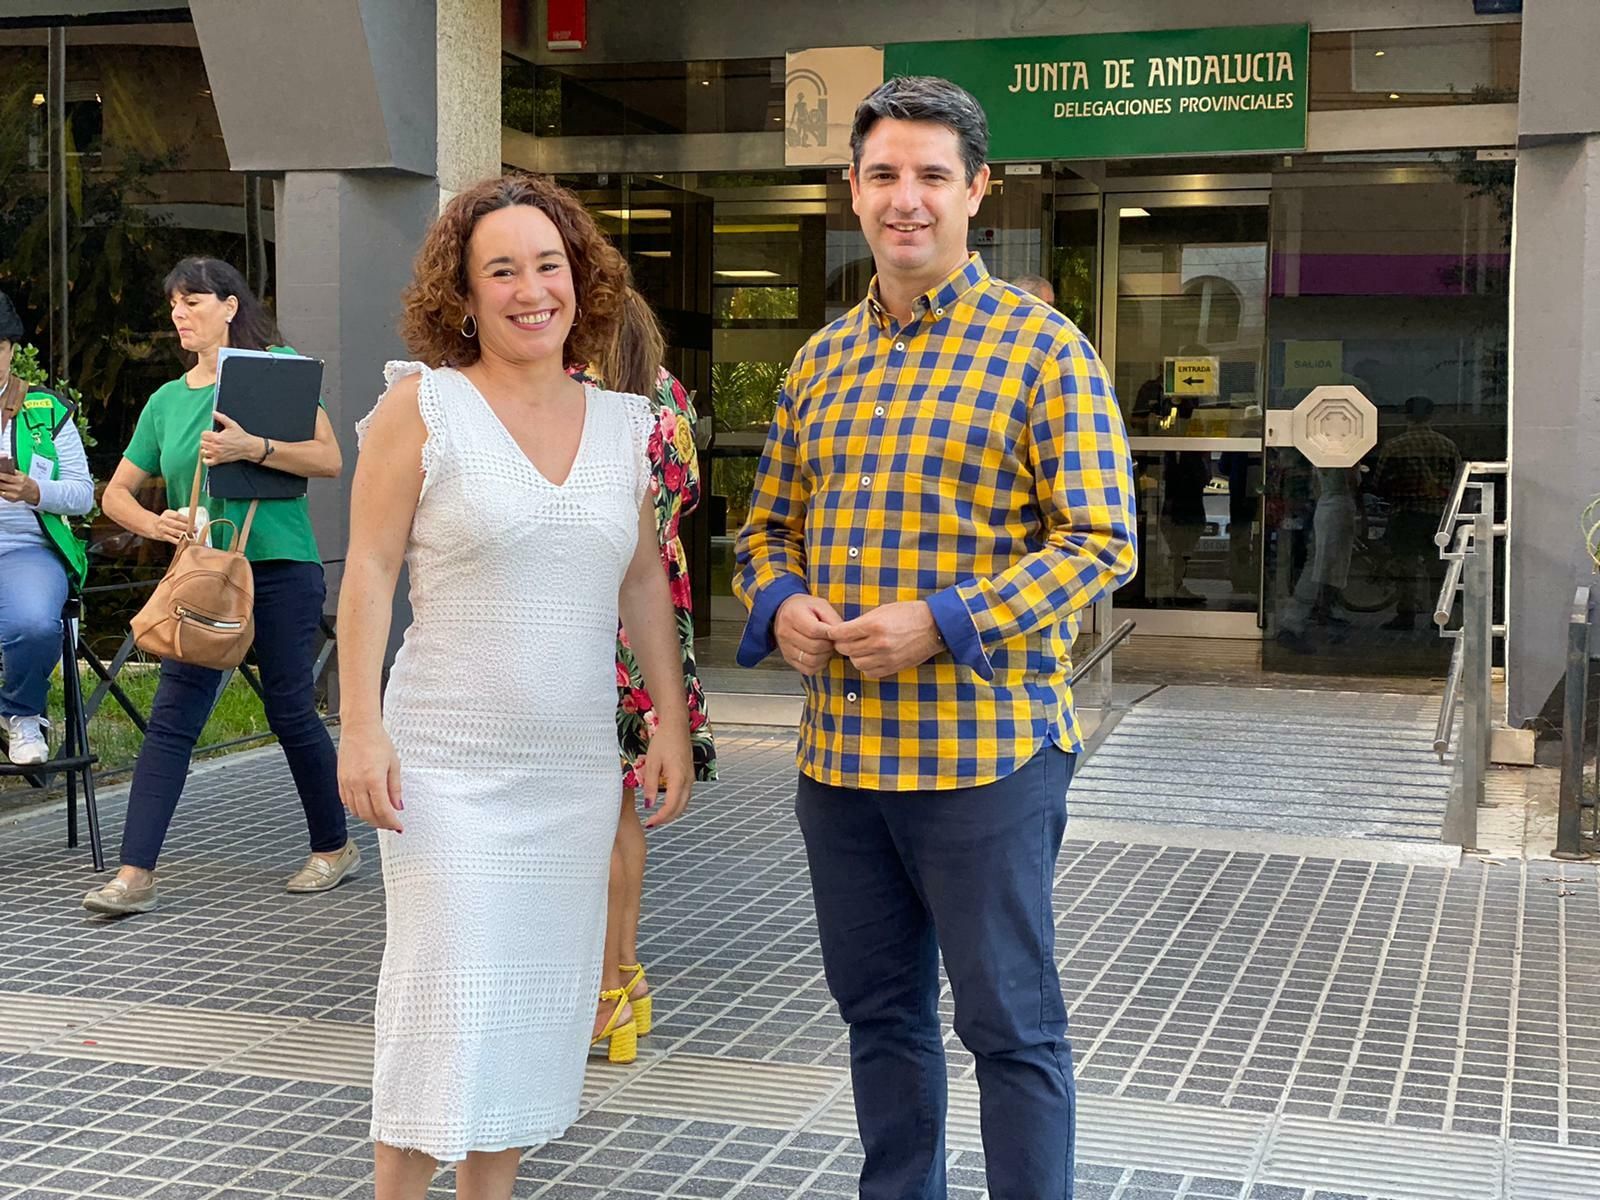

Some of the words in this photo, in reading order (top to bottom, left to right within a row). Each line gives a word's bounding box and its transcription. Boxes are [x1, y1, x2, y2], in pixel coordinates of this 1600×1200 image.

[1008, 61, 1089, 92] JUNTA
[1103, 59, 1134, 88] DE
[1148, 52, 1294, 87] ANDALUCIA
[1054, 98, 1172, 118] DELEGACIONES
[1180, 93, 1294, 113] PROVINCIALES
[1178, 365, 1211, 373] ENTRADA
[1294, 360, 1332, 369] SALIDA
